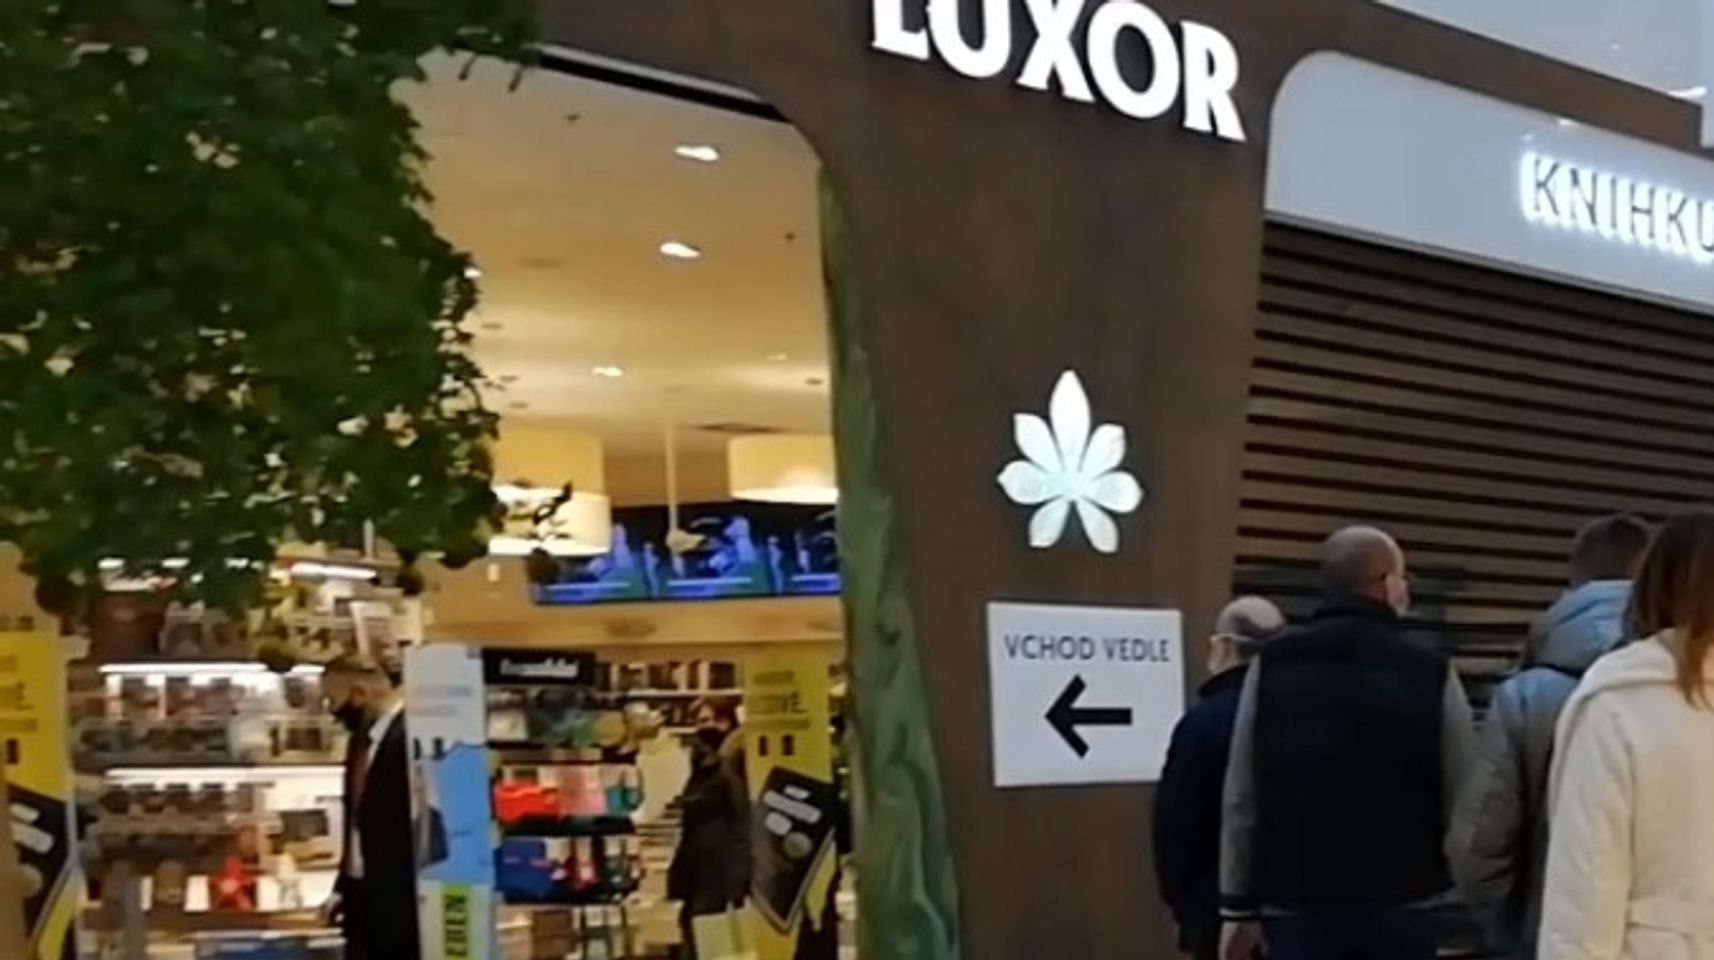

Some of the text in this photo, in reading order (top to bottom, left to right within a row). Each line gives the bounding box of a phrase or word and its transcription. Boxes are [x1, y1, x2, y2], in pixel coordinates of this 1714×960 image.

[872, 0, 1245, 141] LUXOR
[1004, 635, 1169, 662] VCHOD VEDLE
